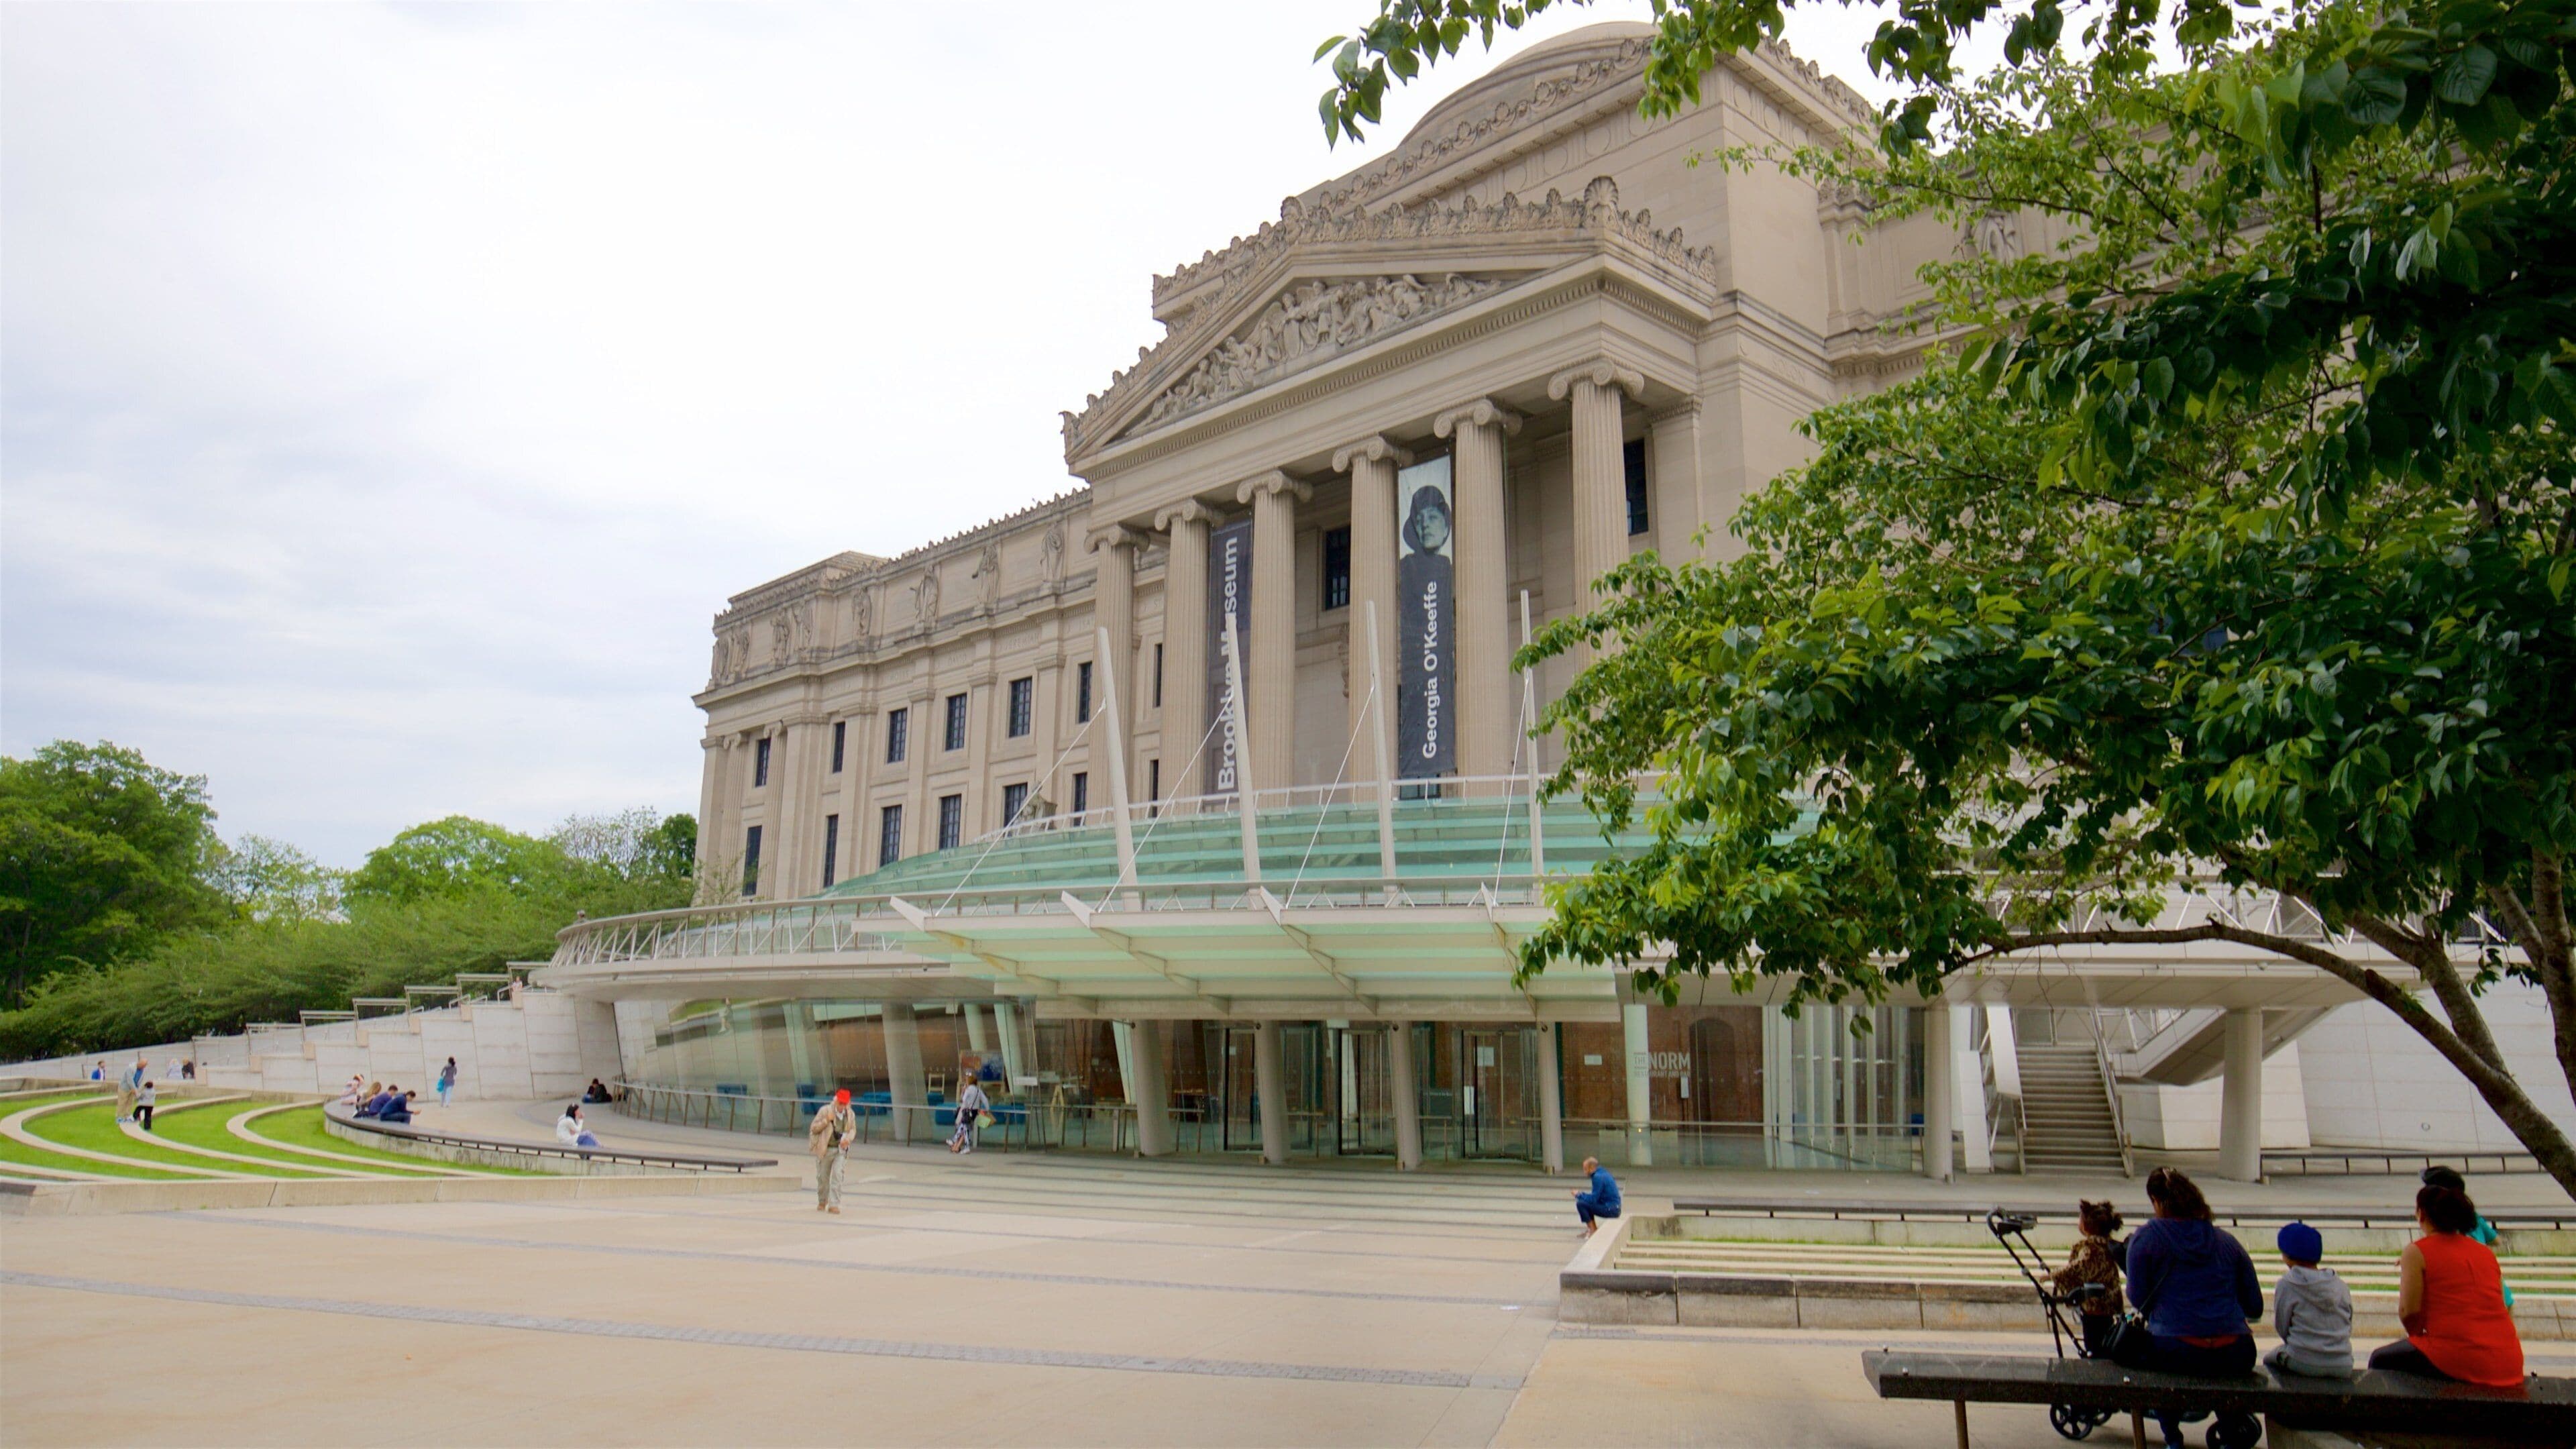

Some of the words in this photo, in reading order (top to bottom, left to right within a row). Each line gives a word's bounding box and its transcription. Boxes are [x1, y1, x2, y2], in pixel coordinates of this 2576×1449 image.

[1423, 581, 1438, 672] O'Keeffe
[1422, 676, 1440, 759] Georgia
[1634, 1056, 1646, 1066] THE
[1649, 1051, 1690, 1070] NORM
